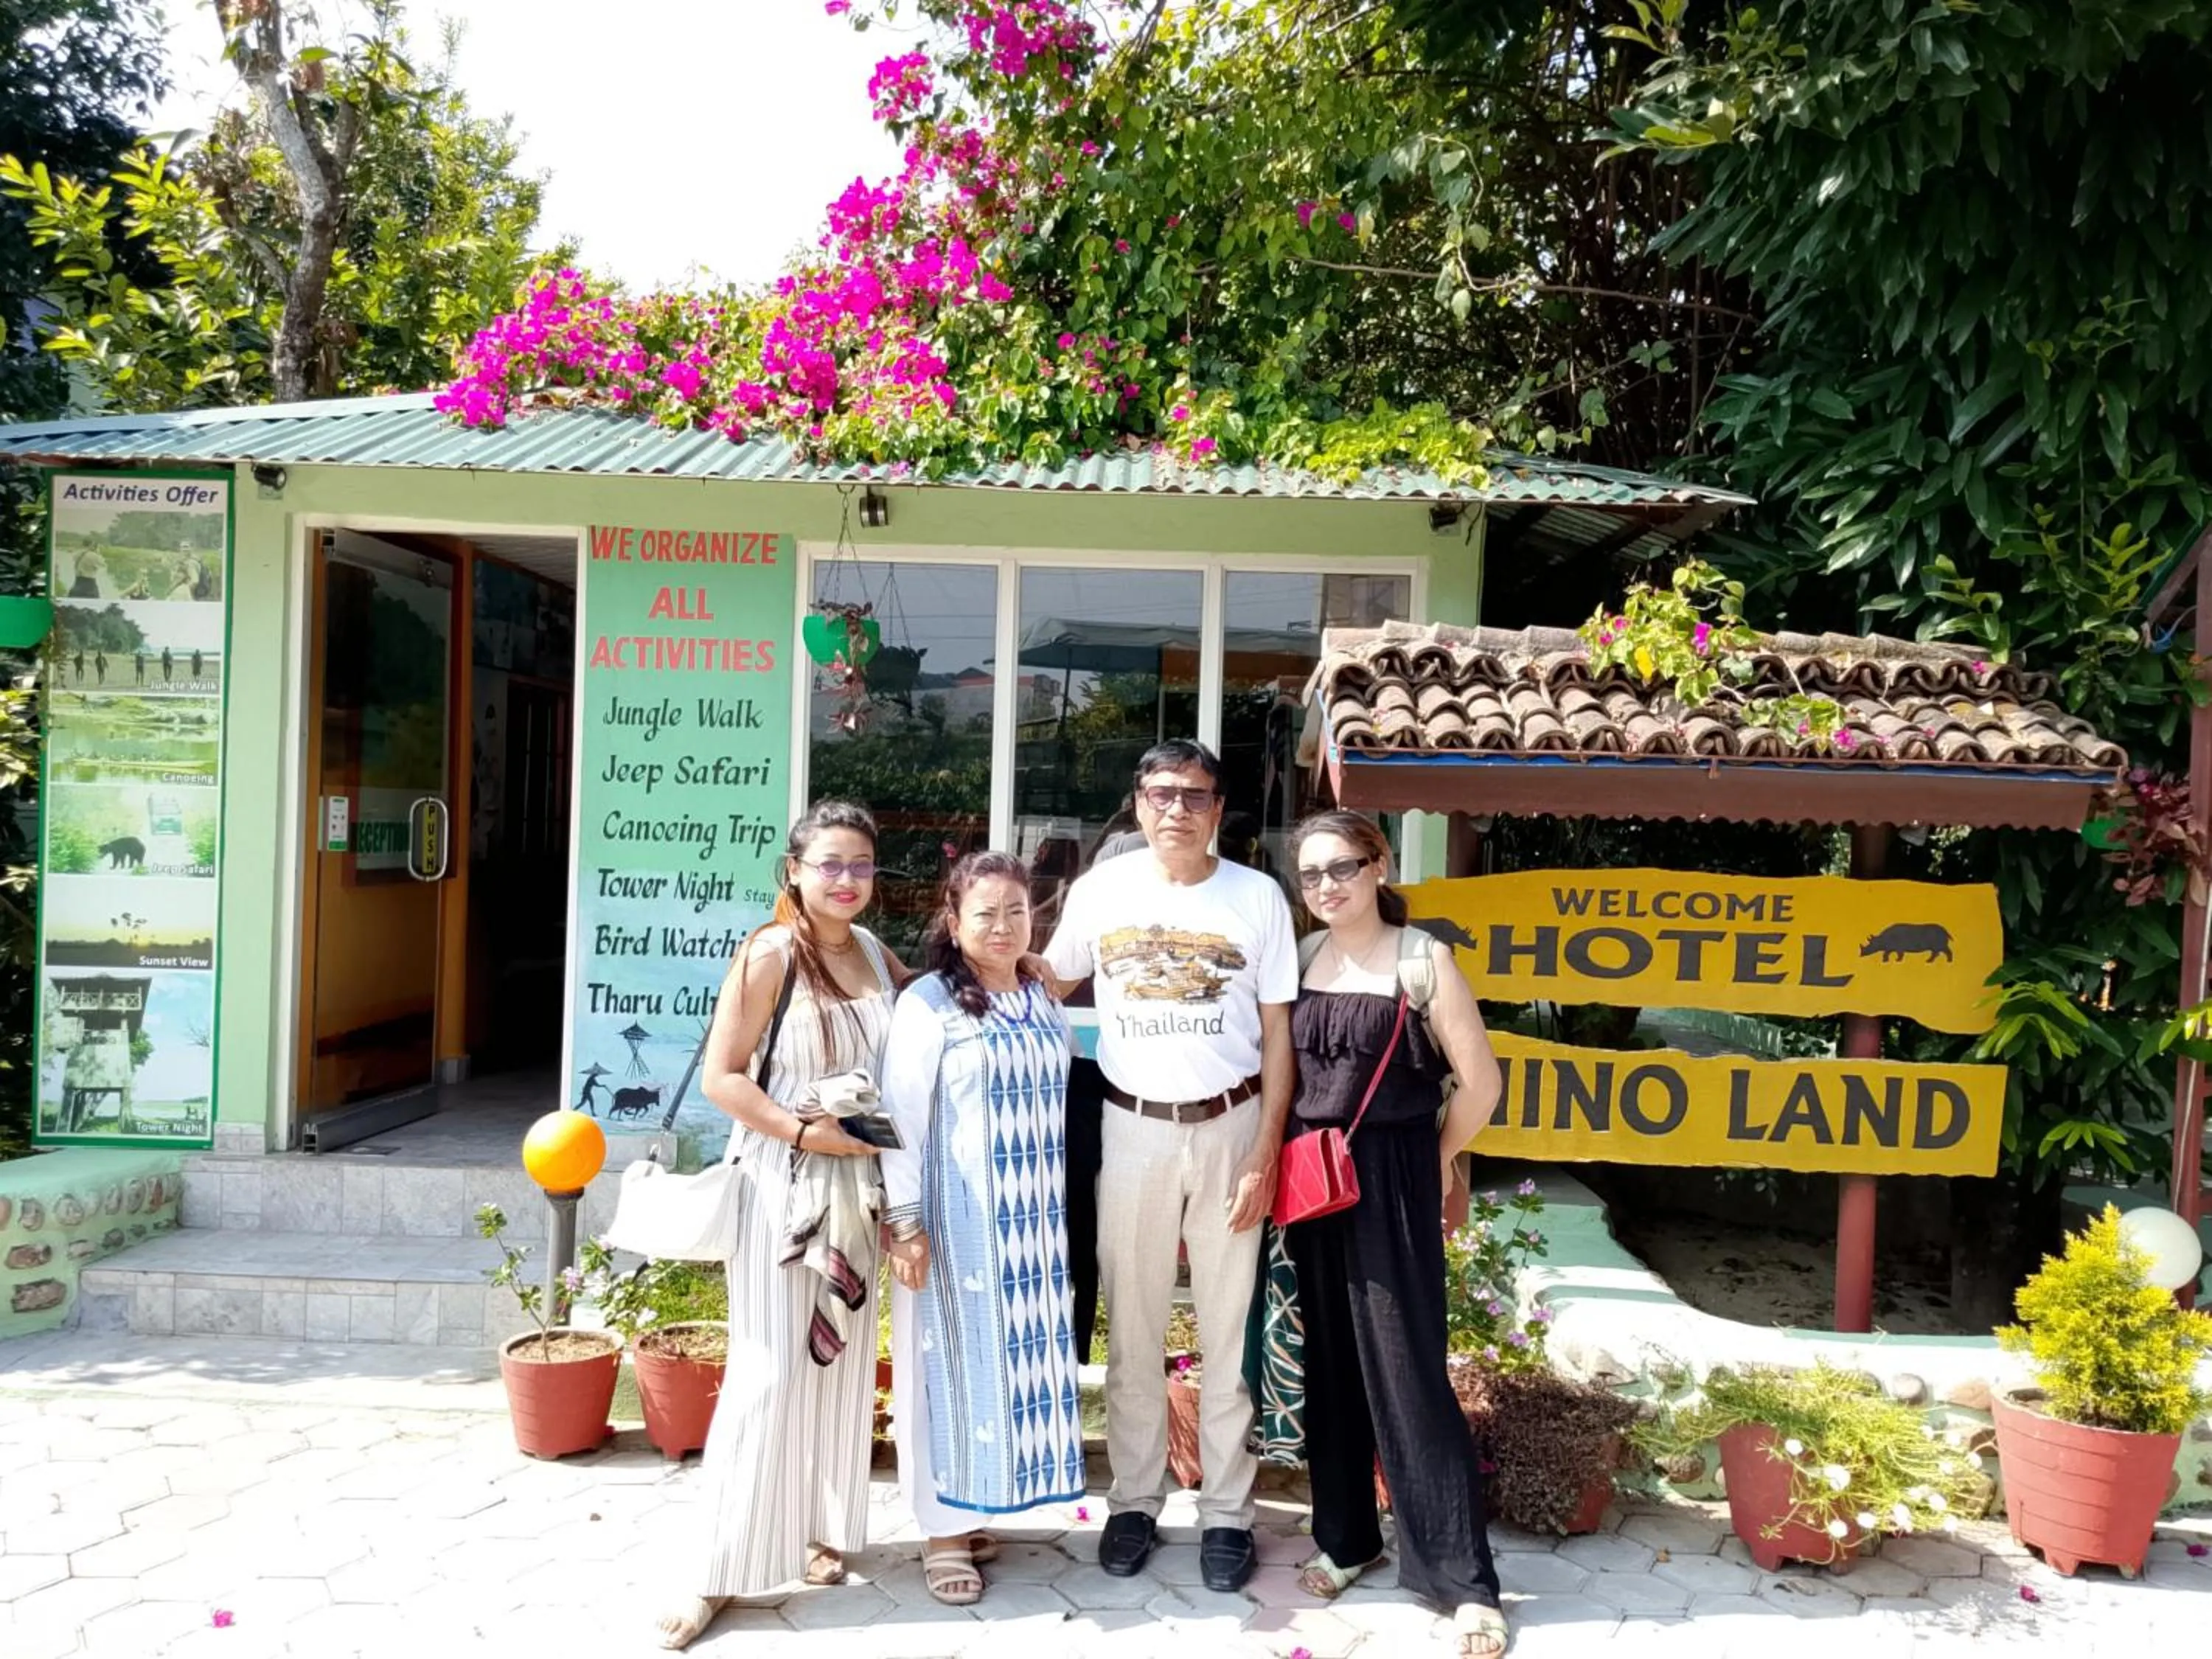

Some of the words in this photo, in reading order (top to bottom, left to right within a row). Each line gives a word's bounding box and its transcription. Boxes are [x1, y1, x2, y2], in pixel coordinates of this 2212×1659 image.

[63, 483, 159, 502] Activities
[166, 486, 218, 506] Offer
[591, 525, 633, 561] WE
[639, 530, 779, 565] ORGANIZE
[648, 587, 714, 620] ALL
[590, 636, 776, 672] ACTIVITIES
[150, 680, 186, 692] Jungle
[189, 681, 218, 691] Walk
[602, 696, 682, 742] Jungle
[698, 698, 764, 729] Walk
[162, 772, 215, 785] Canoeing
[602, 755, 663, 795] Jeep
[674, 755, 771, 785] Safari
[426, 804, 436, 869] PUSH
[602, 810, 718, 860] Canoeing
[728, 814, 776, 858] Trip
[598, 868, 668, 900] Tower
[674, 871, 736, 914] Night
[744, 888, 775, 911] Stay
[1551, 887, 1795, 922] WELCOME
[595, 924, 653, 956] Bird
[662, 926, 747, 959] Watchi
[1486, 923, 1855, 988] HOTEL
[139, 955, 177, 967] Sunset
[179, 956, 209, 967] View
[588, 983, 663, 1016] Tharu
[1116, 1009, 1225, 1039] Thailand
[1489, 1057, 1689, 1135] INO
[1726, 1068, 1972, 1150] LAND
[136, 1121, 170, 1133] Tower
